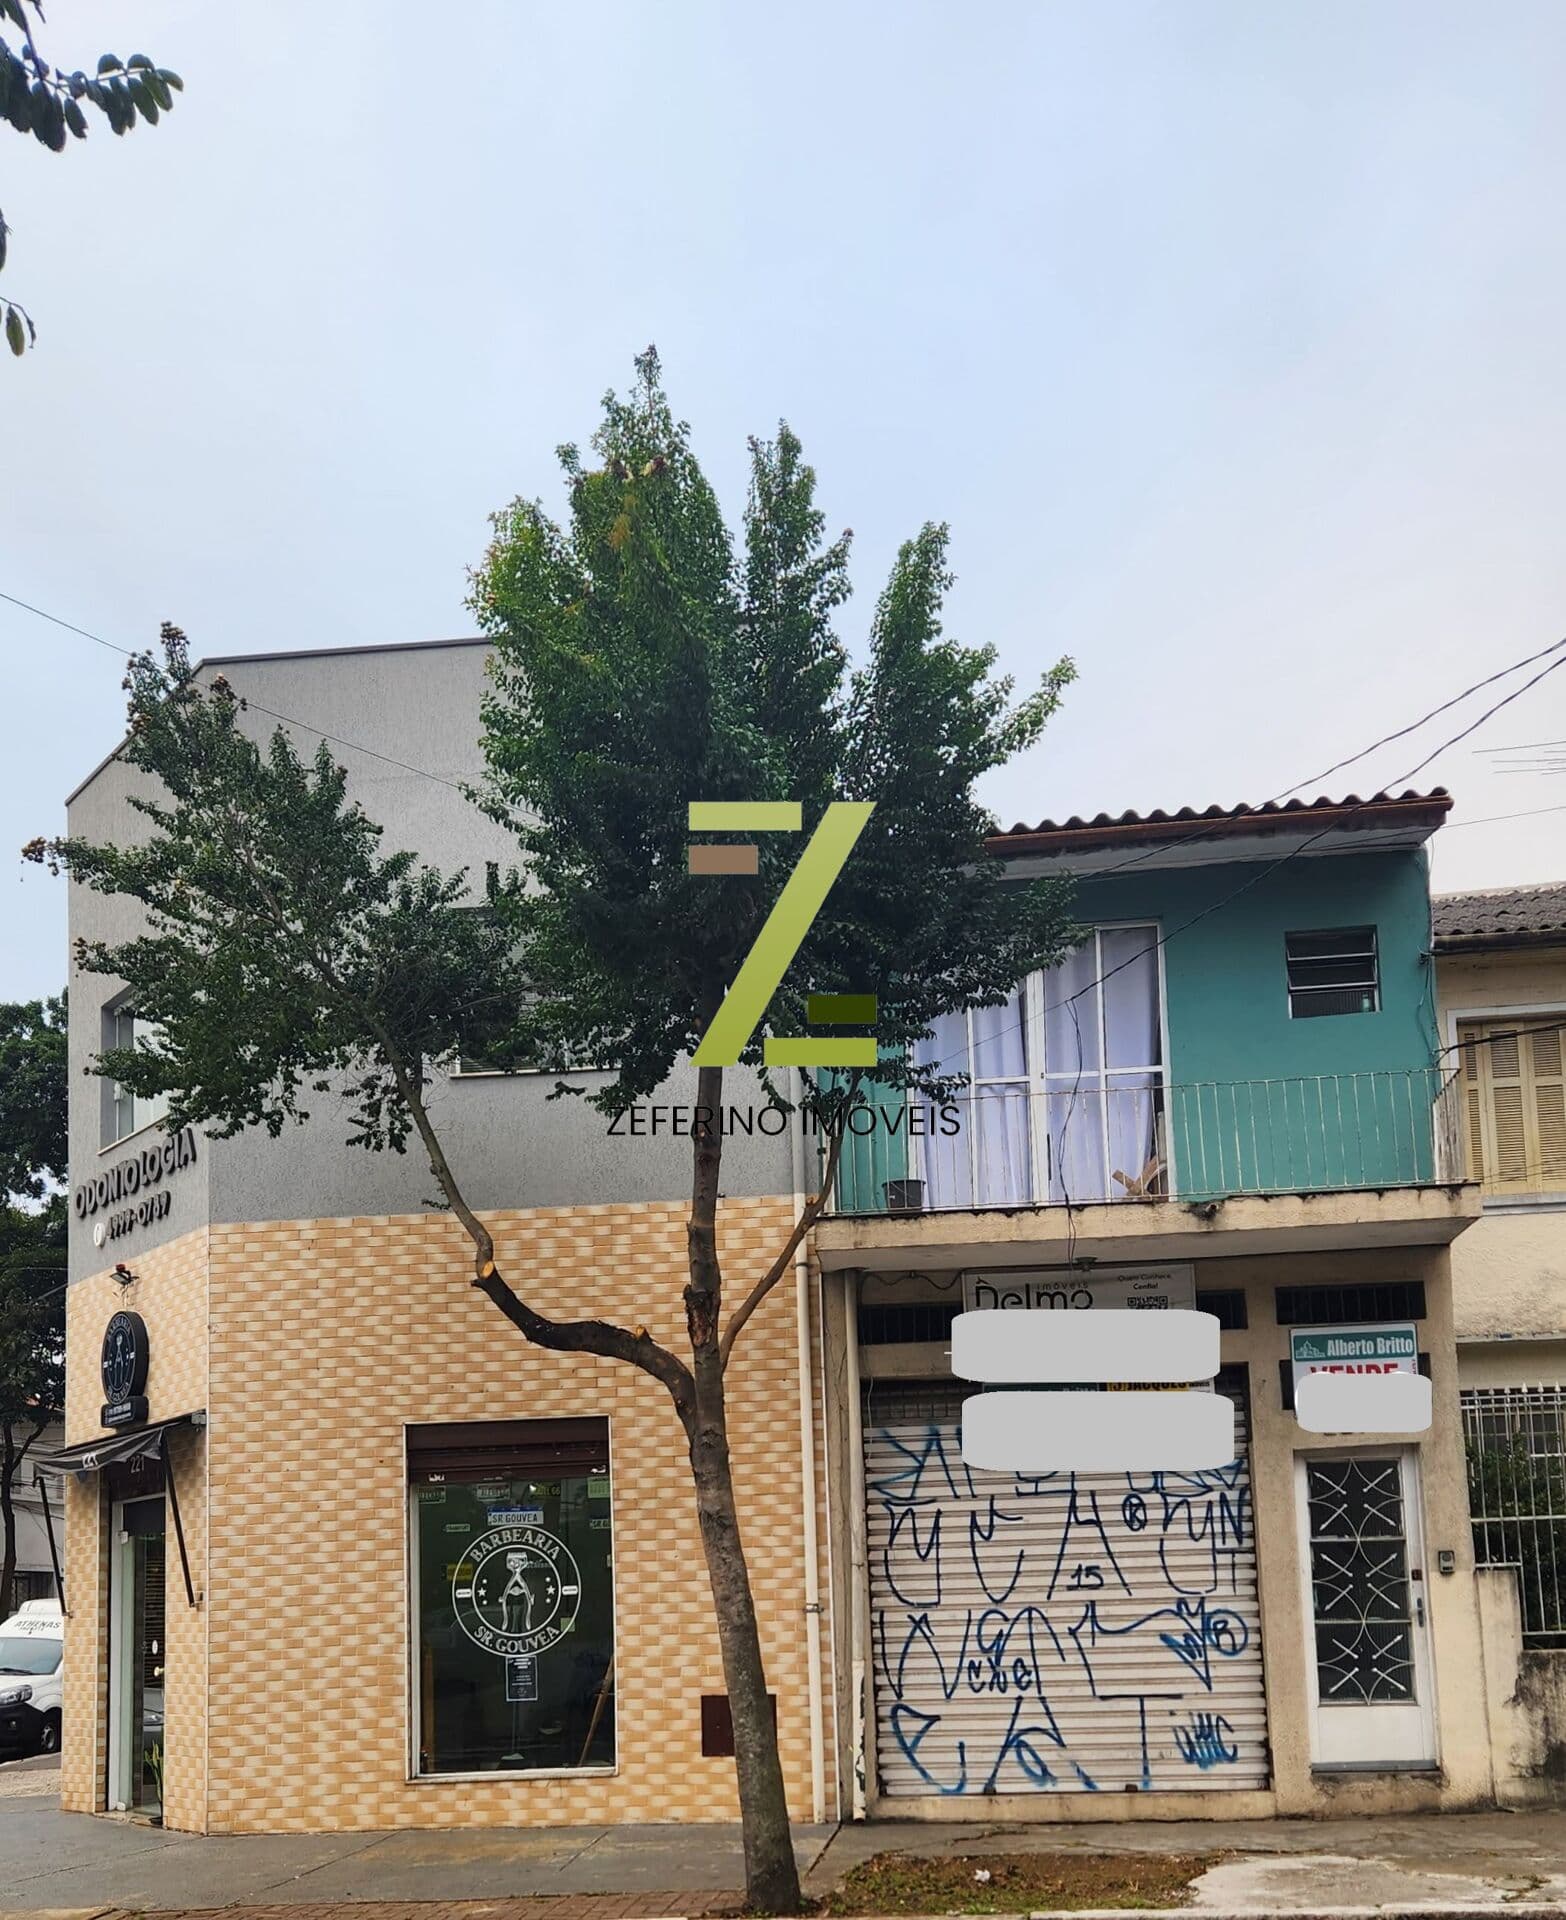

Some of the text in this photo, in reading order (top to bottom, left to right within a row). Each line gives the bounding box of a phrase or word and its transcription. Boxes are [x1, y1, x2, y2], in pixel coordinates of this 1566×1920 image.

[74, 1127, 197, 1219] ODONTOLOGIA
[1327, 1336, 1413, 1356] Alberto Britto
[130, 1455, 145, 1474] 221
[505, 1513, 538, 1523] GOUVEA
[469, 1528, 561, 1562] BARBEARIA
[1070, 1565, 1105, 1590] 15
[474, 1625, 561, 1654] SR. GOUVEA
